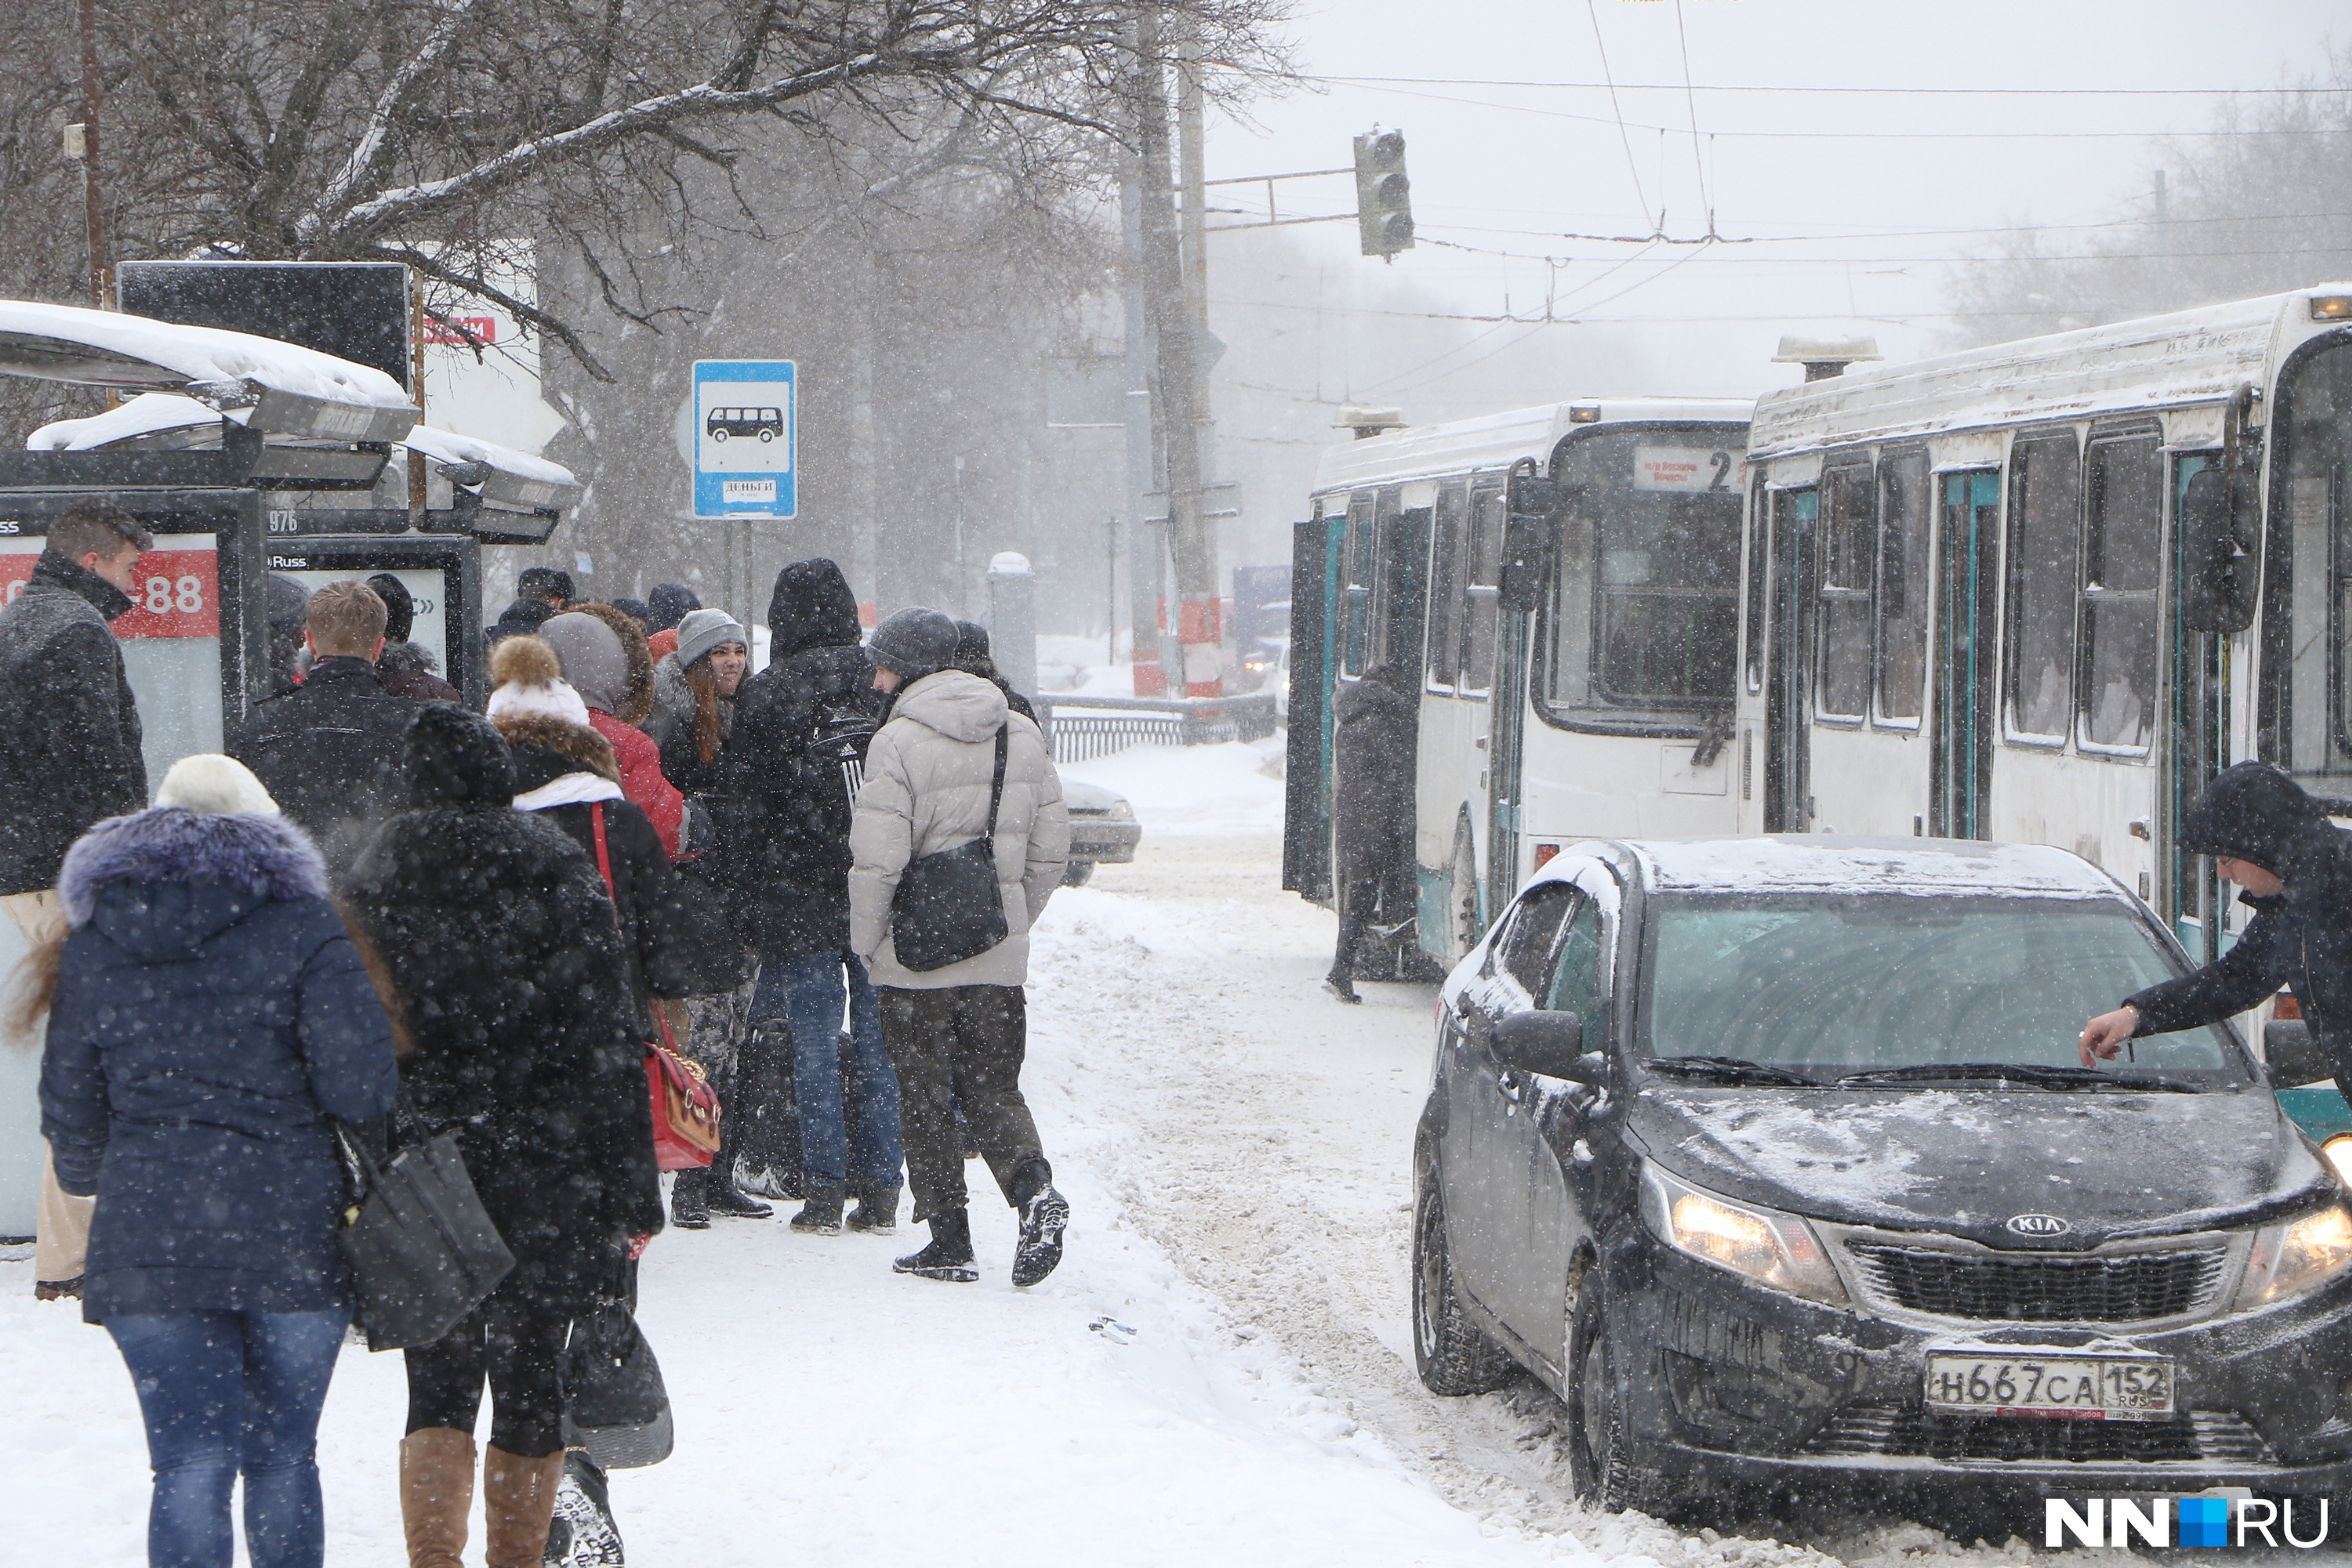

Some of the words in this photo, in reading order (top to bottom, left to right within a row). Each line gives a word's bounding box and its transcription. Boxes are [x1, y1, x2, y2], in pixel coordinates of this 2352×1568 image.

[1709, 451, 1732, 492] 2
[725, 482, 773, 493] ДЕНЬГИ
[273, 555, 307, 568] Russ
[2018, 1218, 2061, 1231] KIA
[2105, 1366, 2165, 1397] 152
[2118, 1395, 2147, 1408] RUS
